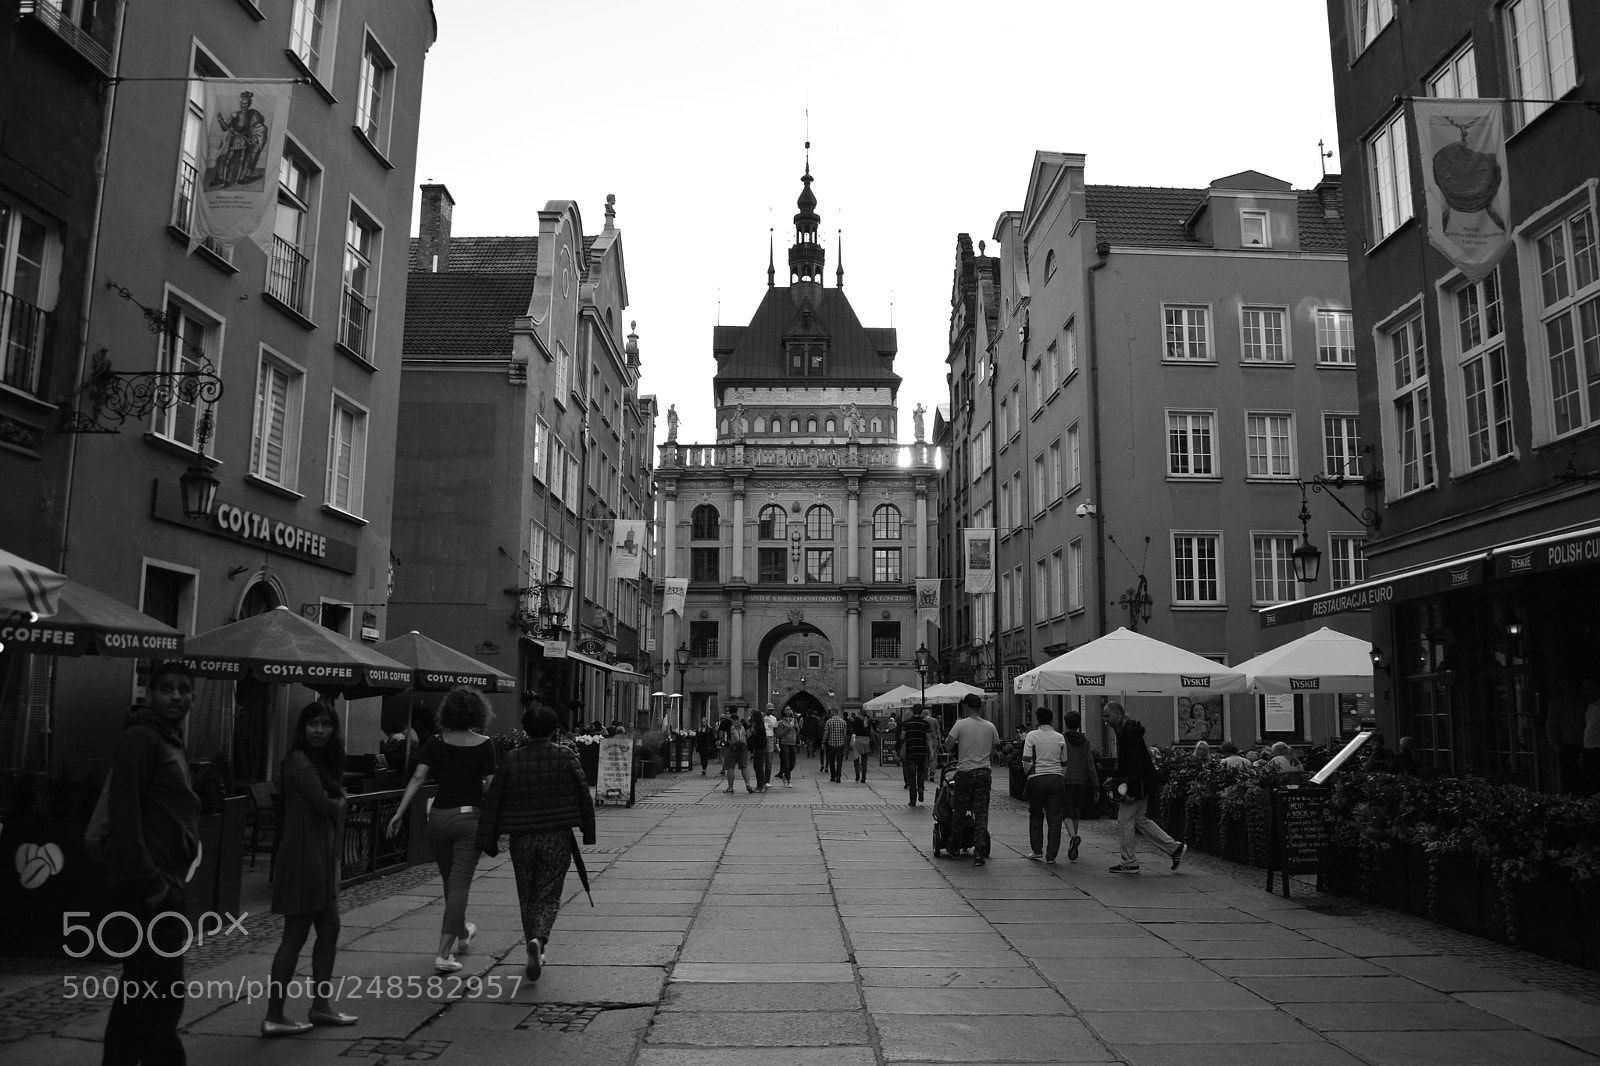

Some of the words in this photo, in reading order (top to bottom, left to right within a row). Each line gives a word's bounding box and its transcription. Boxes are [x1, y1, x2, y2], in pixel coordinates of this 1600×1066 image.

[217, 503, 271, 541] COSTA
[274, 521, 327, 558] COFFEE
[1548, 542, 1583, 565] POLISH
[1511, 556, 1531, 569] TYSKIE
[1312, 591, 1367, 616] RESTAURACJA
[1368, 586, 1393, 604] EURO
[1, 627, 75, 645] COFFEE
[105, 633, 140, 648] COSTA
[142, 635, 178, 650] COFFEE
[200, 660, 240, 672] COFFEE
[263, 664, 304, 675] COSTA
[308, 666, 352, 678] COFFEE
[369, 670, 389, 681] COSTA
[390, 671, 410, 682] COFFEE
[427, 674, 454, 683] COSTA
[457, 675, 487, 686] COFFEE
[1077, 676, 1104, 685] TYSKIE
[1182, 677, 1209, 686] TYSKIE
[1292, 680, 1318, 688] TYSKIE
